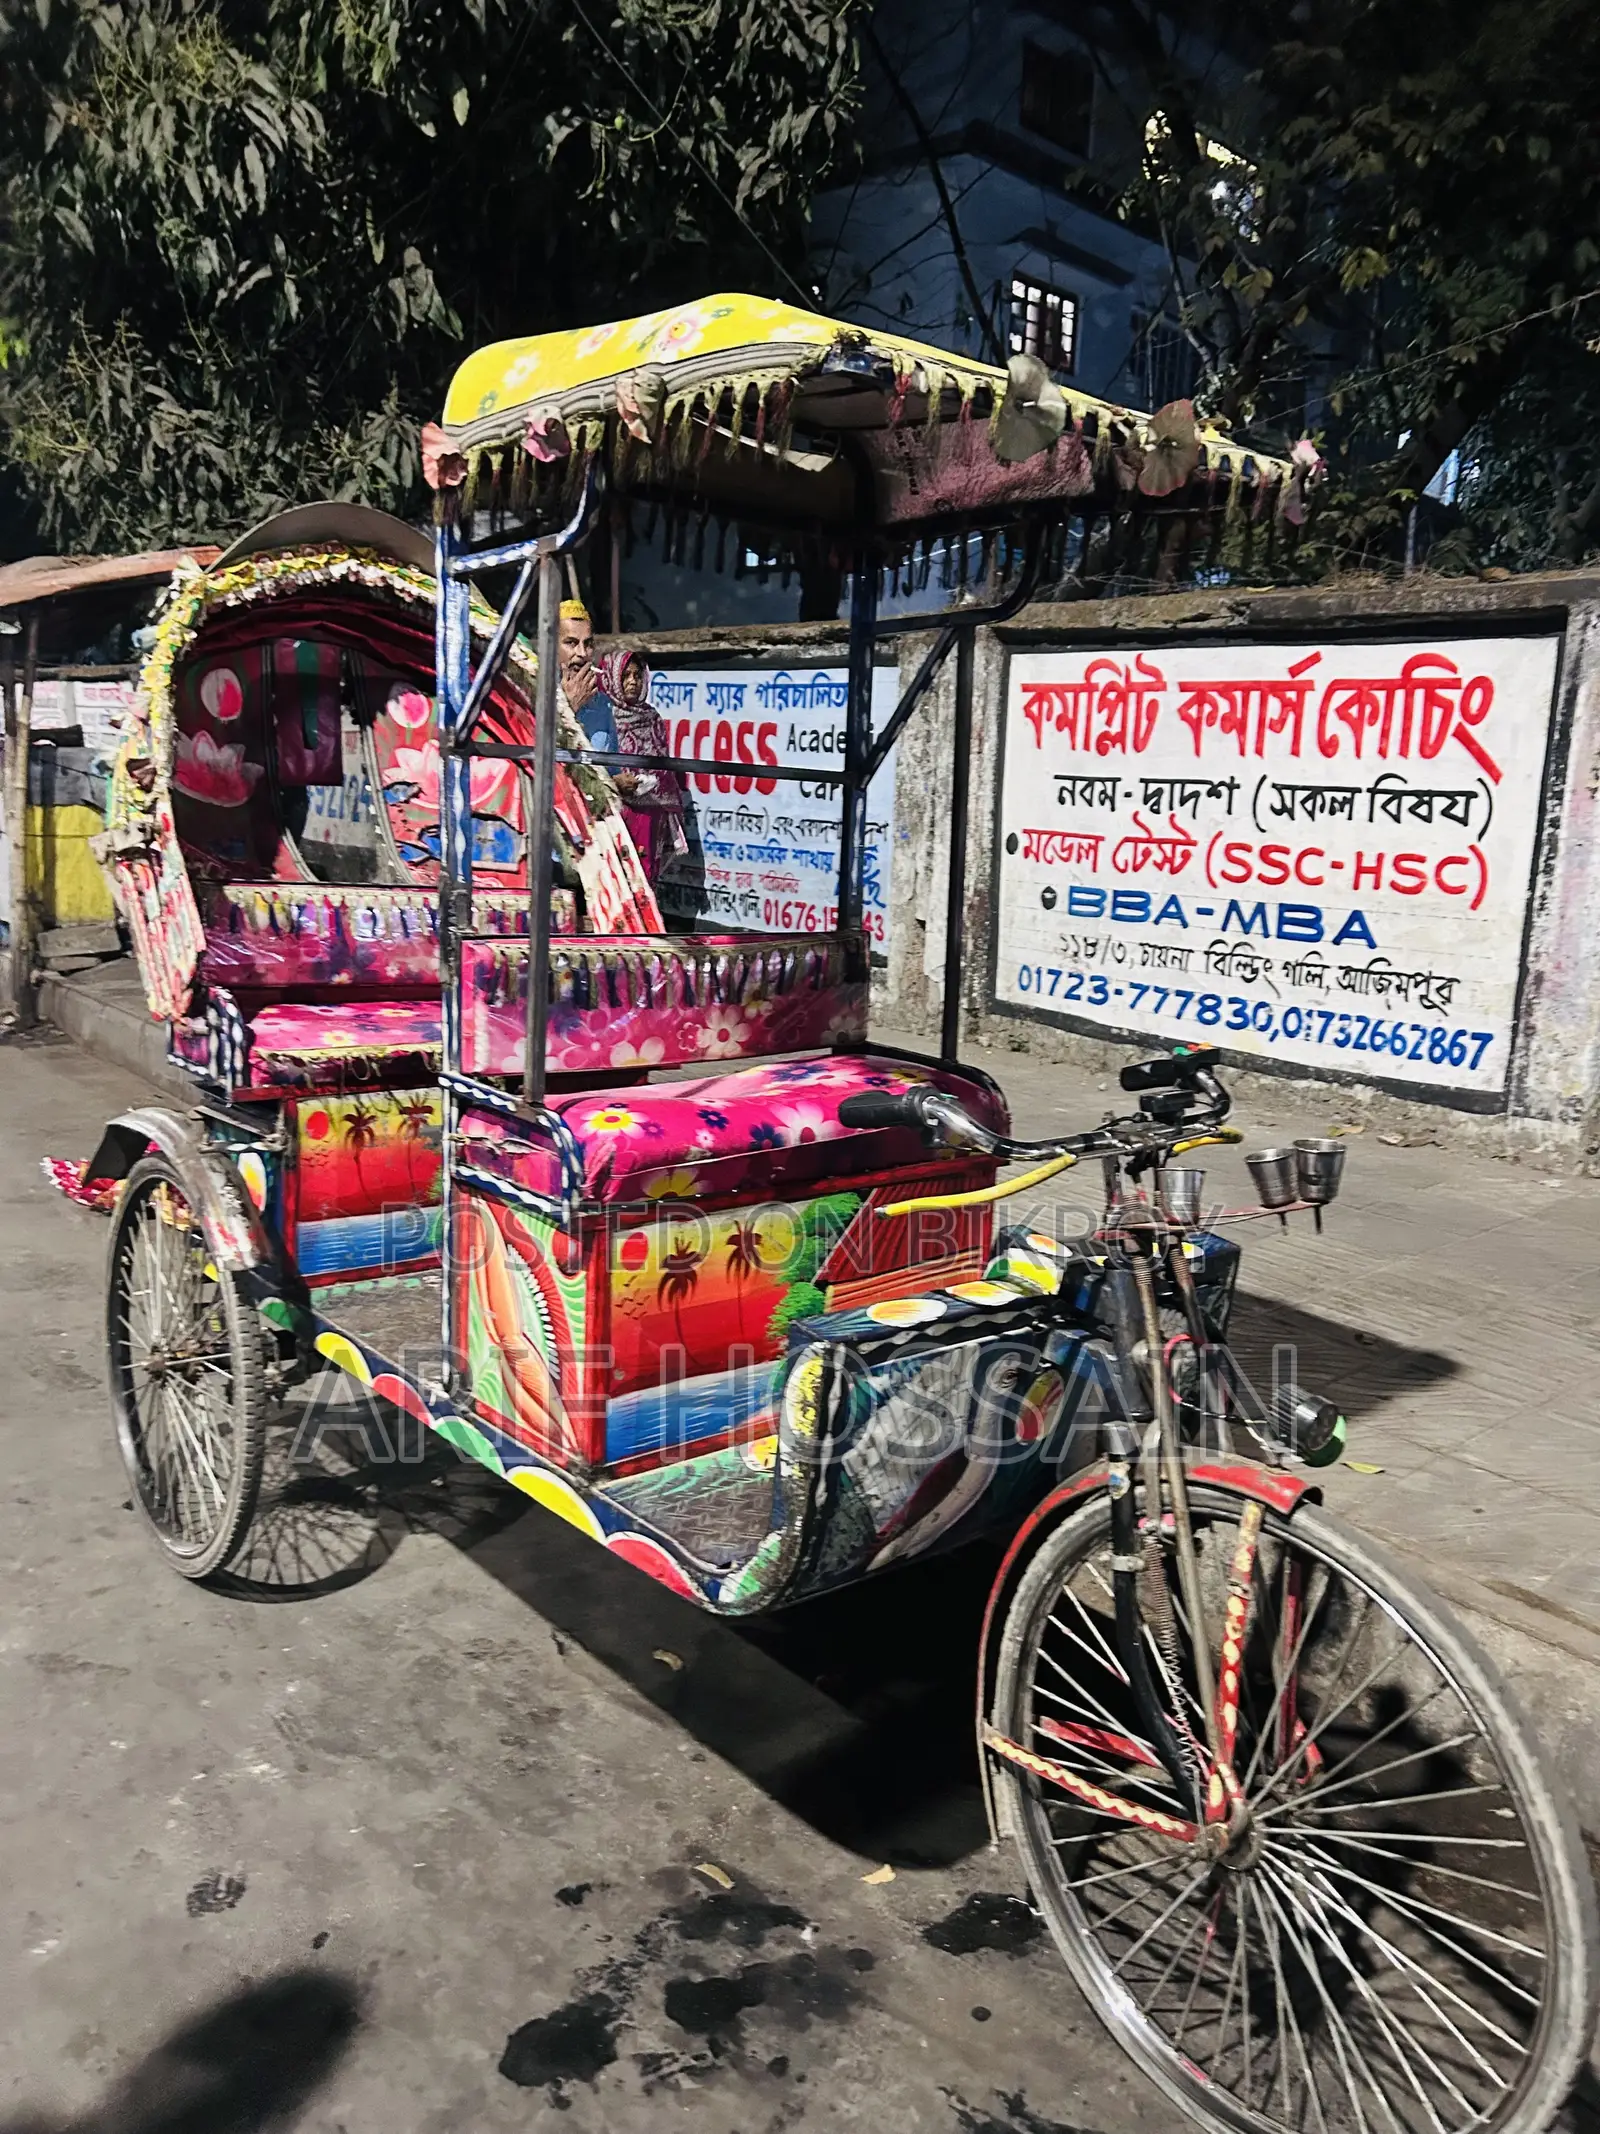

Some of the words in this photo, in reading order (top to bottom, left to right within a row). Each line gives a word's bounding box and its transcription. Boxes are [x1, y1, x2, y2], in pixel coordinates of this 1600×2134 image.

[706, 682, 748, 715] স্যার
[1021, 653, 1168, 757] কমপ্লিট
[1178, 651, 1323, 759] কমার্স
[1317, 652, 1504, 786] কোচিং
[1022, 827, 1105, 873] মডেল
[1111, 810, 1198, 876] টেস্ট
[1206, 829, 1489, 912] (SSC-HSC)
[1067, 885, 1378, 950] BBA-MBA
